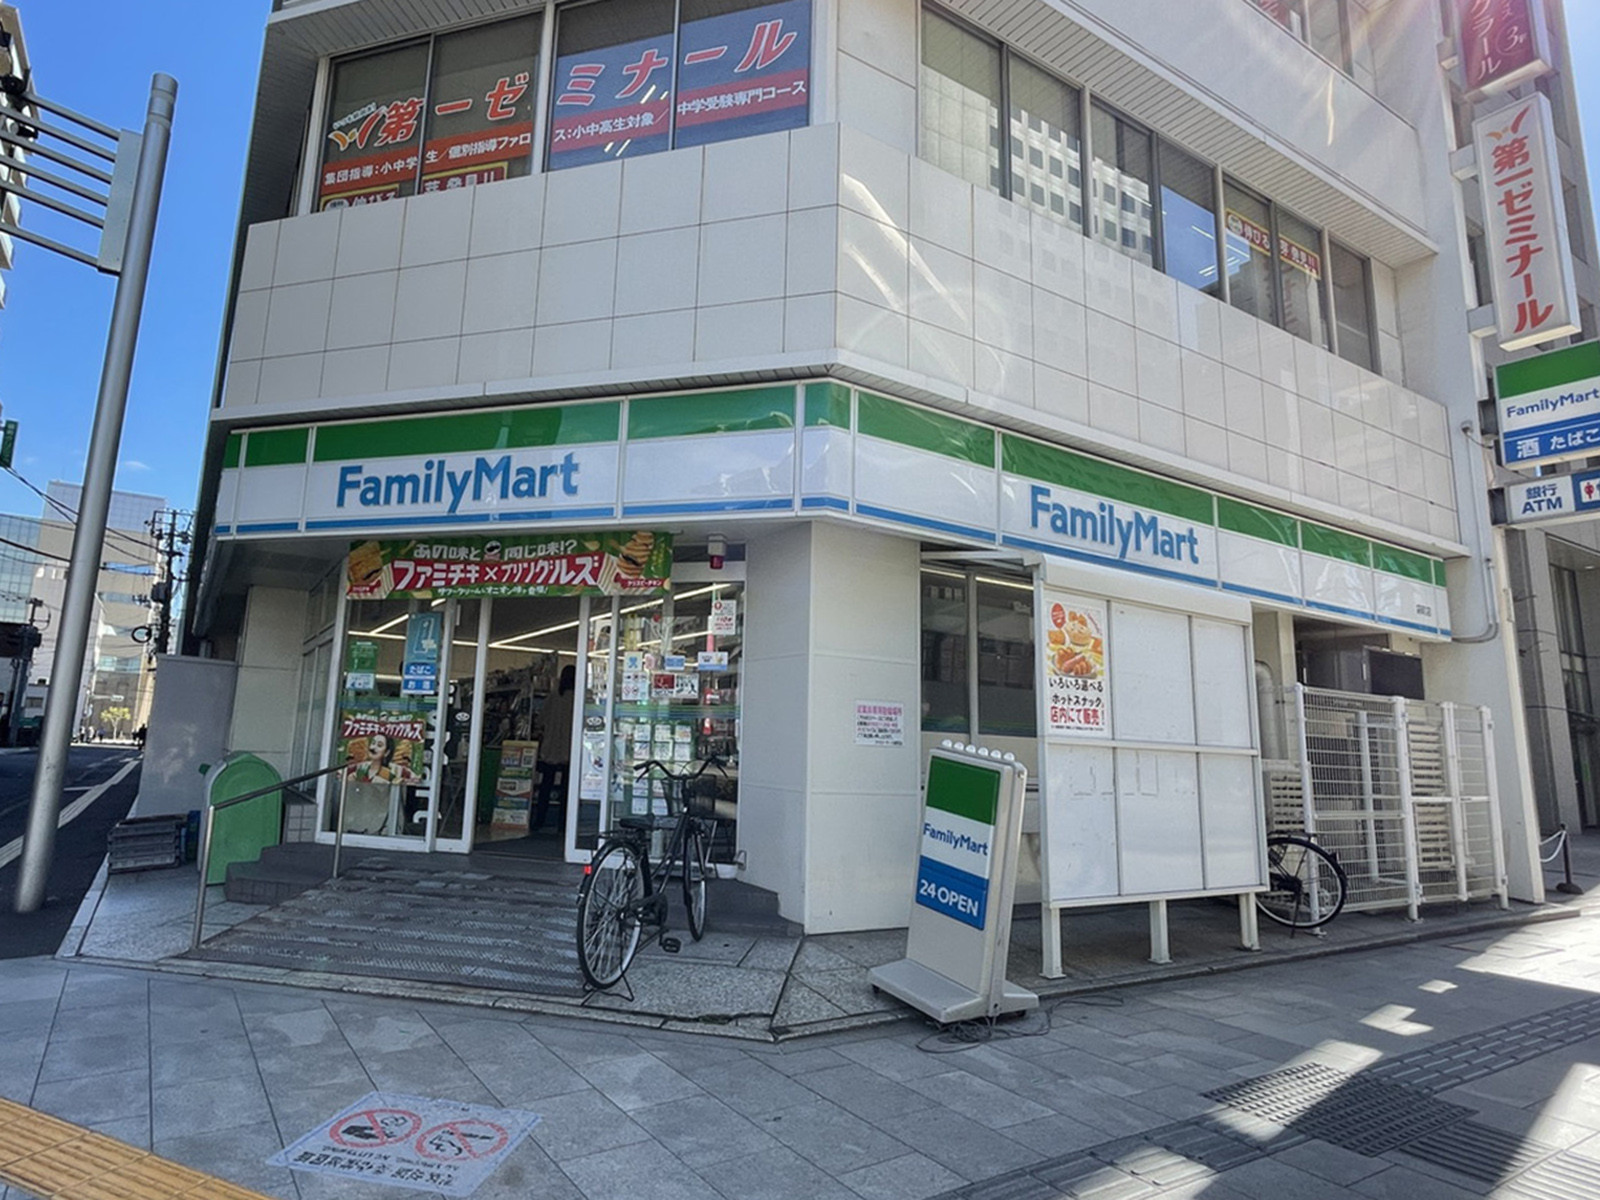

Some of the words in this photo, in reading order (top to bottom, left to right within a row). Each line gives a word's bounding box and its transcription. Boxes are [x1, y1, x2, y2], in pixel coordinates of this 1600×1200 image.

[1491, 134, 1554, 334] 第一ゼミナール
[1506, 387, 1600, 420] FamilyMart
[1516, 436, 1541, 459] 酒
[1550, 427, 1600, 451] たばこ
[336, 451, 580, 514] FamilyMart
[1525, 482, 1558, 500] 銀行
[1521, 496, 1563, 515] ATM
[1030, 484, 1199, 564] FamilyMart
[413, 543, 481, 561] あの味と
[1049, 677, 1104, 692] いろいろ選べる
[1052, 694, 1102, 708] ホットスナック
[1050, 706, 1100, 726] 店内にて販売
[922, 822, 989, 857] FamilyMart
